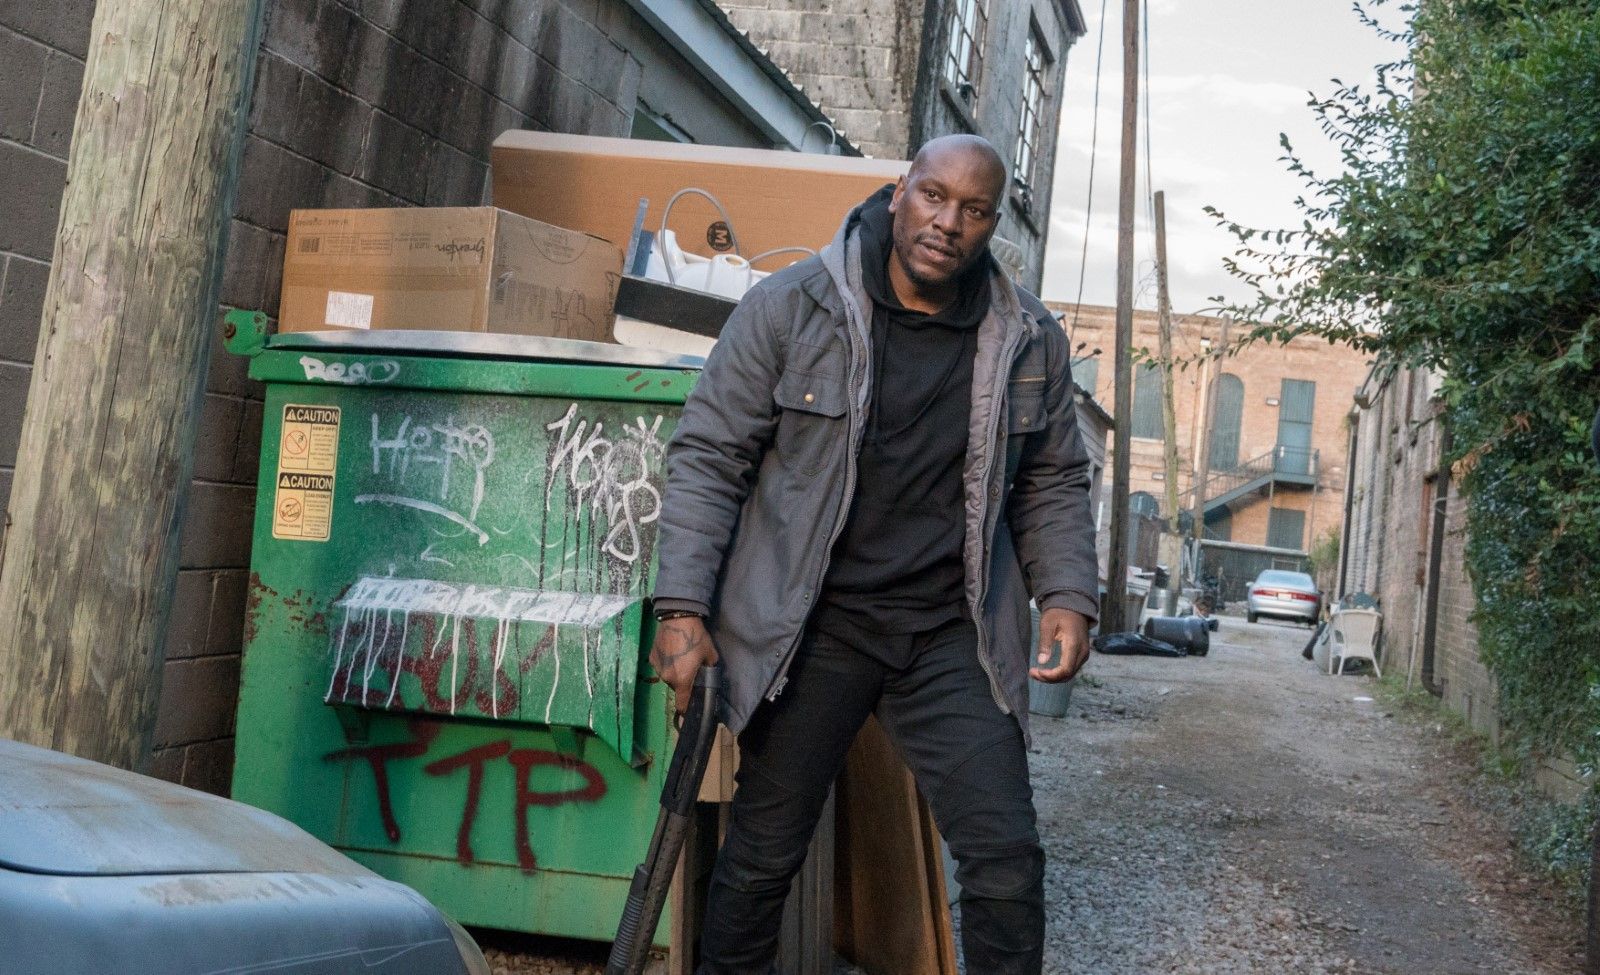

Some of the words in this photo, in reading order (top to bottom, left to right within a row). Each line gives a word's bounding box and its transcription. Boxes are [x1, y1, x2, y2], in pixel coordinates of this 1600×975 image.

[296, 408, 339, 424] CAUTION
[290, 475, 333, 490] CAUTION
[321, 739, 607, 875] TTP
